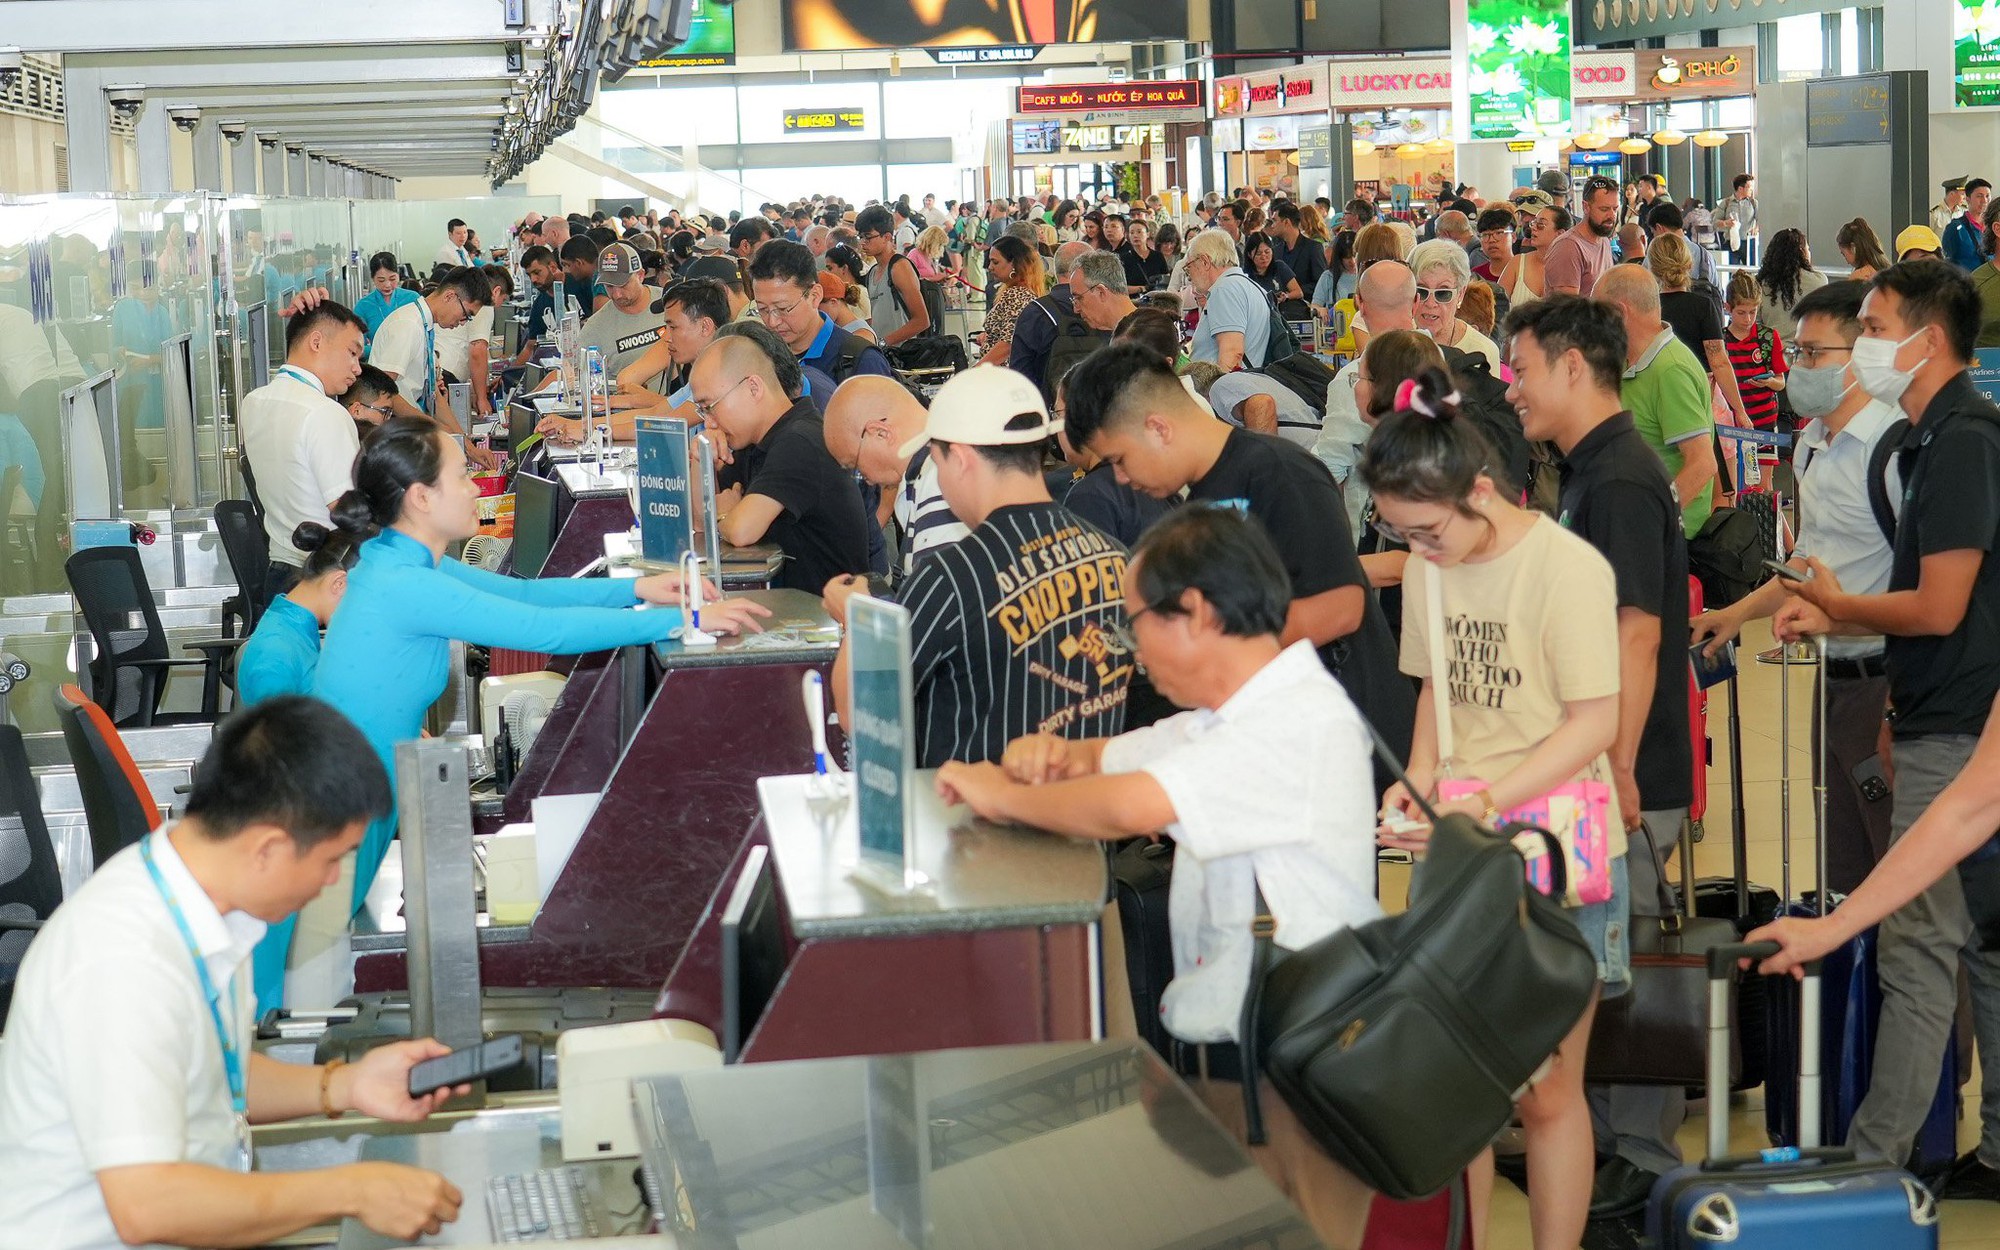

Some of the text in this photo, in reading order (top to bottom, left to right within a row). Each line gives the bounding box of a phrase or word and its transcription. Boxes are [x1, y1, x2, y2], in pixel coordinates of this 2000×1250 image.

[1341, 73, 1414, 92] LUCKY
[1035, 96, 1056, 106] CAFE
[1147, 92, 1163, 101] HOA
[1114, 125, 1163, 146] CAFE
[619, 331, 659, 350] SWOOSH.
[649, 502, 680, 517] CLOSED
[996, 532, 1111, 594] OLD SCHOOL
[1453, 639, 1499, 664] WHO
[1447, 682, 1505, 708] MUCH
